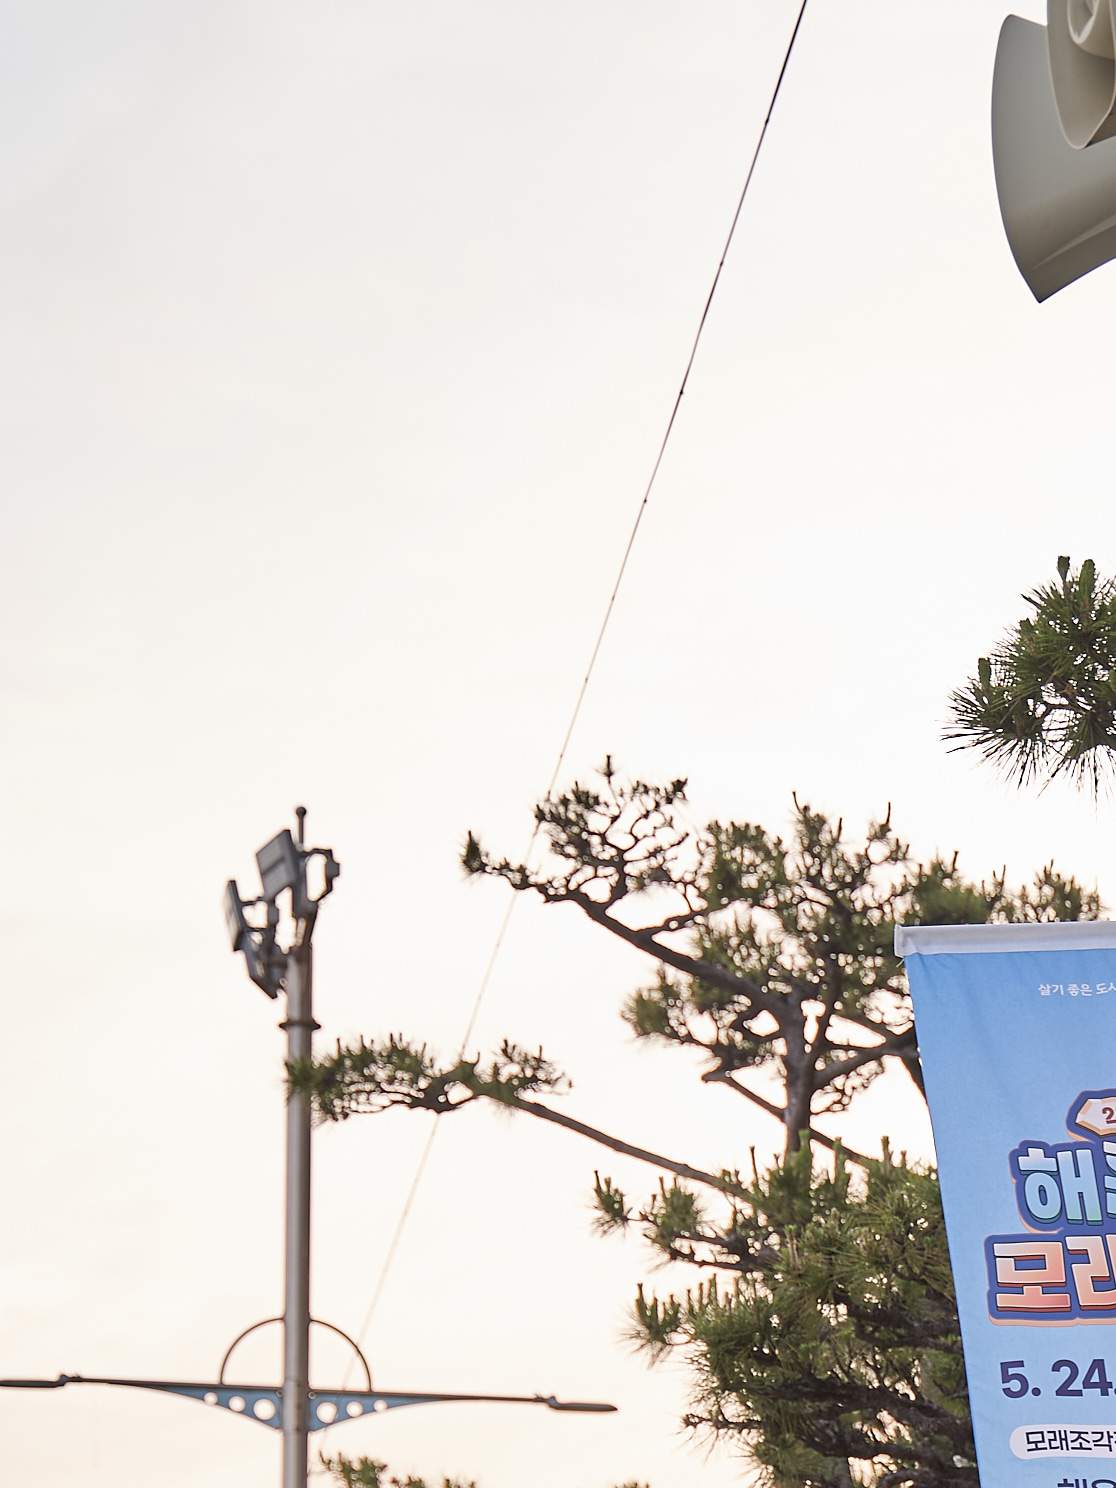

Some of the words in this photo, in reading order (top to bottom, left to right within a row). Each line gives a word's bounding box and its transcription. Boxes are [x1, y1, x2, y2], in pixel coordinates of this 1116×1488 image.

[1038, 983, 1065, 996] 살기
[1067, 983, 1093, 997] 좋은
[1000, 1360, 1042, 1400] 5.
